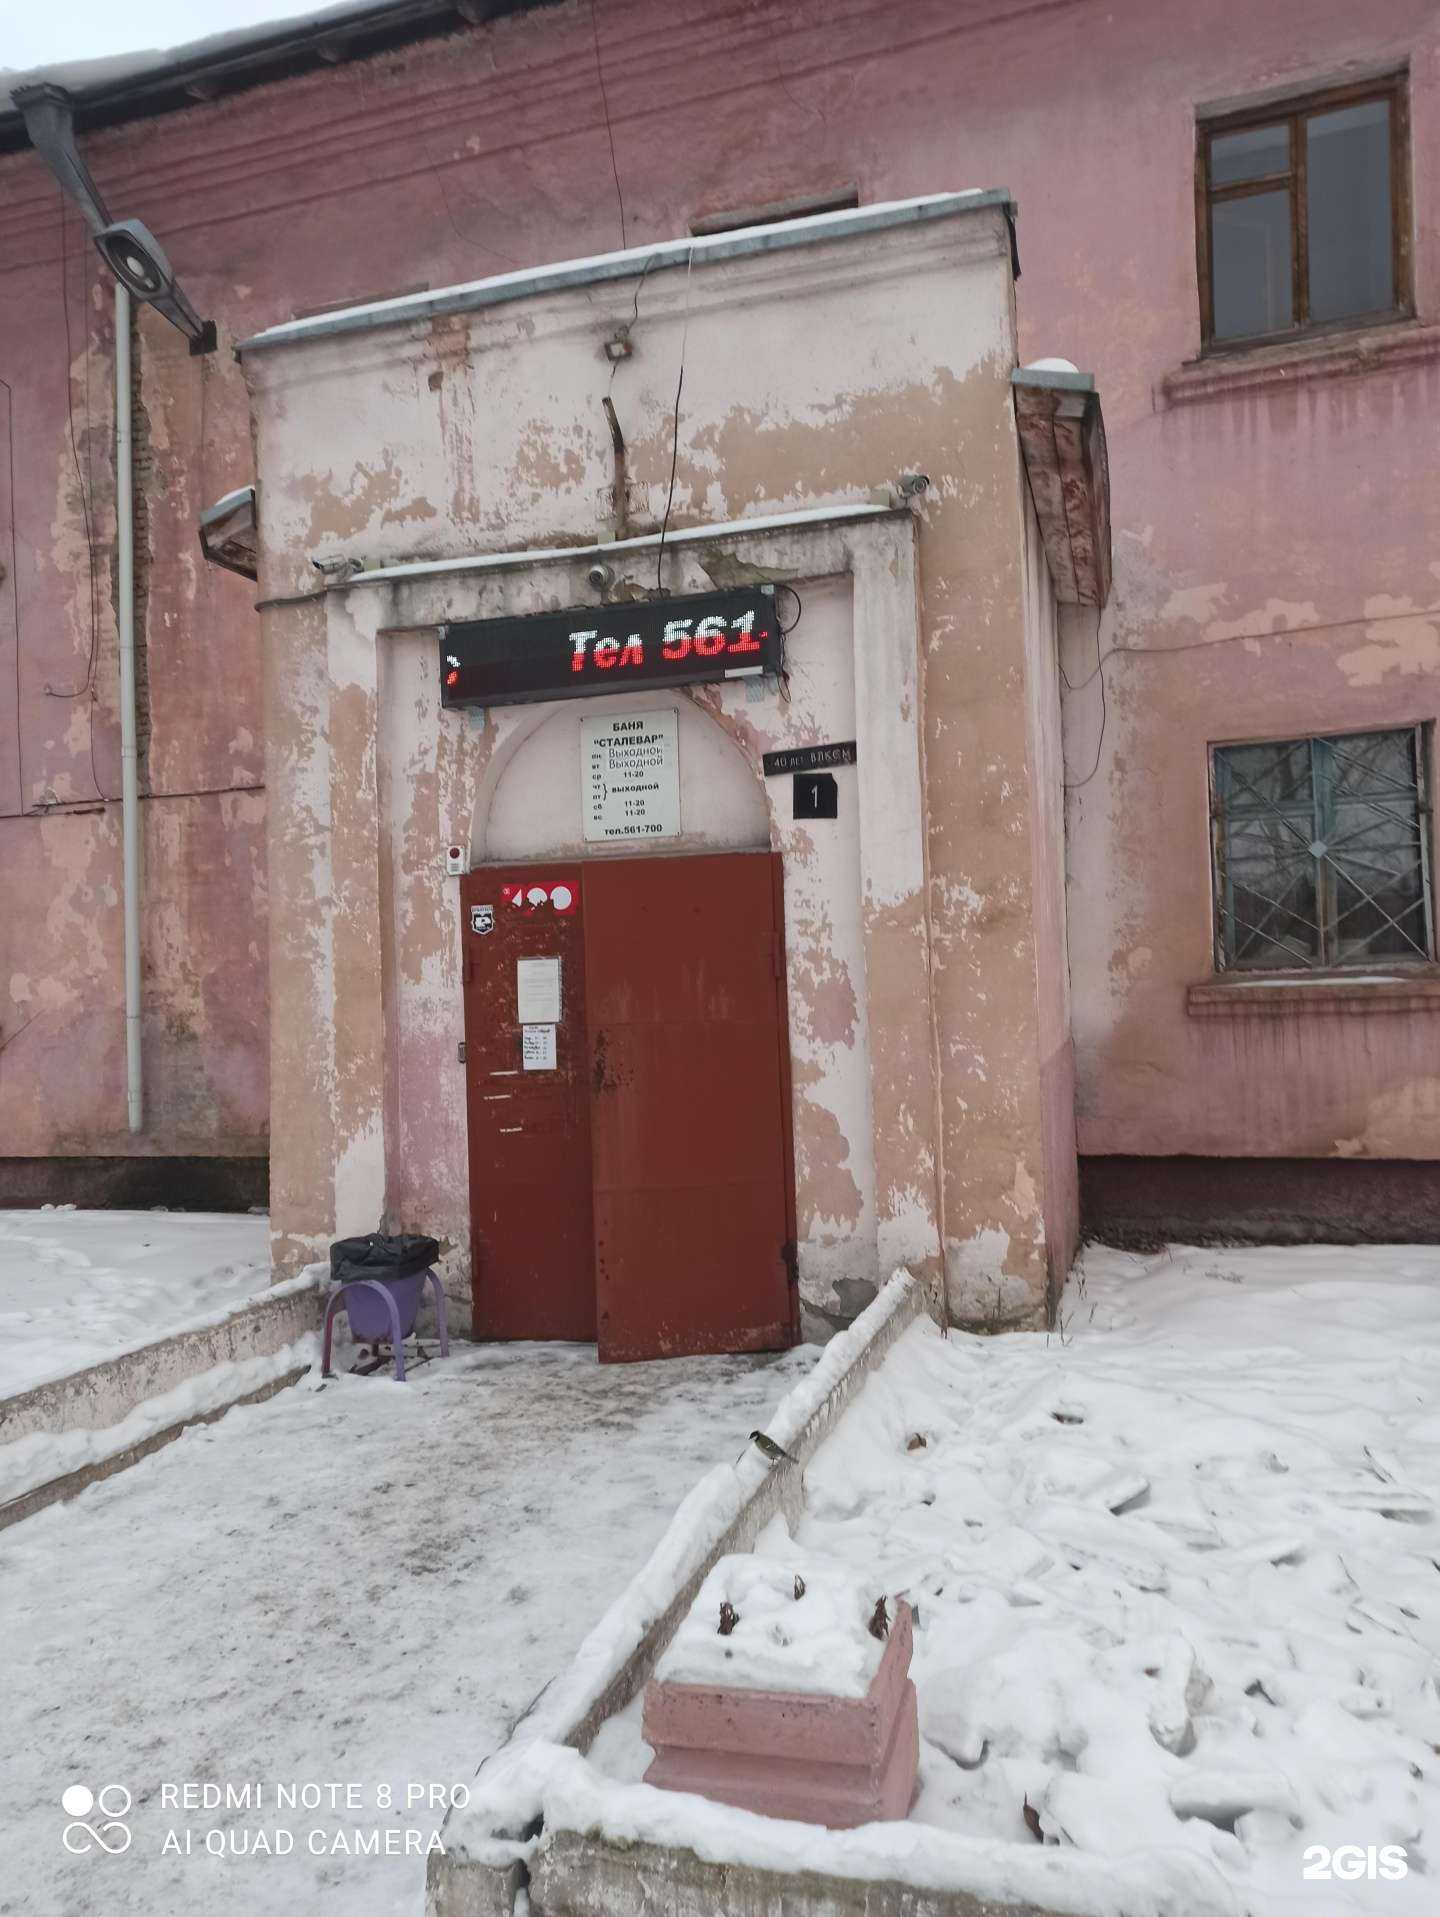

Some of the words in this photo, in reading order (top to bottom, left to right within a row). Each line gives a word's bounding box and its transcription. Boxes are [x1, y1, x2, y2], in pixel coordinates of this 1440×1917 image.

[568, 629, 645, 672] Тел
[612, 721, 644, 732] БАНЯ
[609, 757, 664, 769] Выходной
[612, 783, 659, 793] выходной
[811, 784, 818, 808] 1
